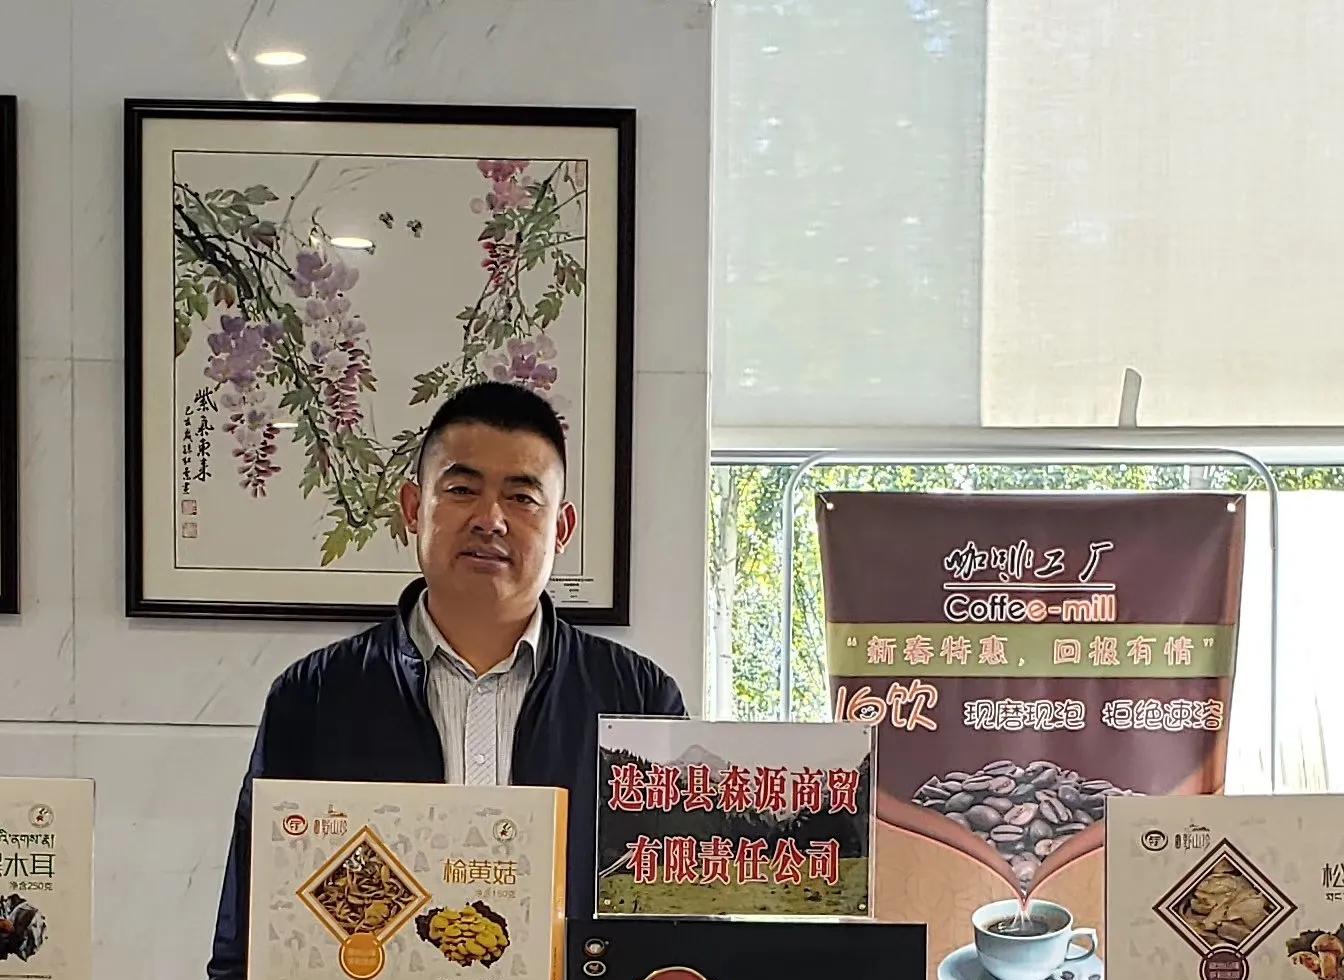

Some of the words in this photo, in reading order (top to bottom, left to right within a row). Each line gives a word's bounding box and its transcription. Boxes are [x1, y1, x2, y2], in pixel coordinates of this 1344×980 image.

[943, 540, 1114, 583] 咖啡工厂
[943, 594, 1119, 623] Coffee-mill
[963, 698, 1086, 731] 现磨现泡
[1102, 699, 1225, 731] 拒绝速溶
[607, 763, 860, 815] 迭部县森源商贸
[443, 858, 517, 886] 榆黄菇
[626, 834, 841, 887] 有限责任公司
